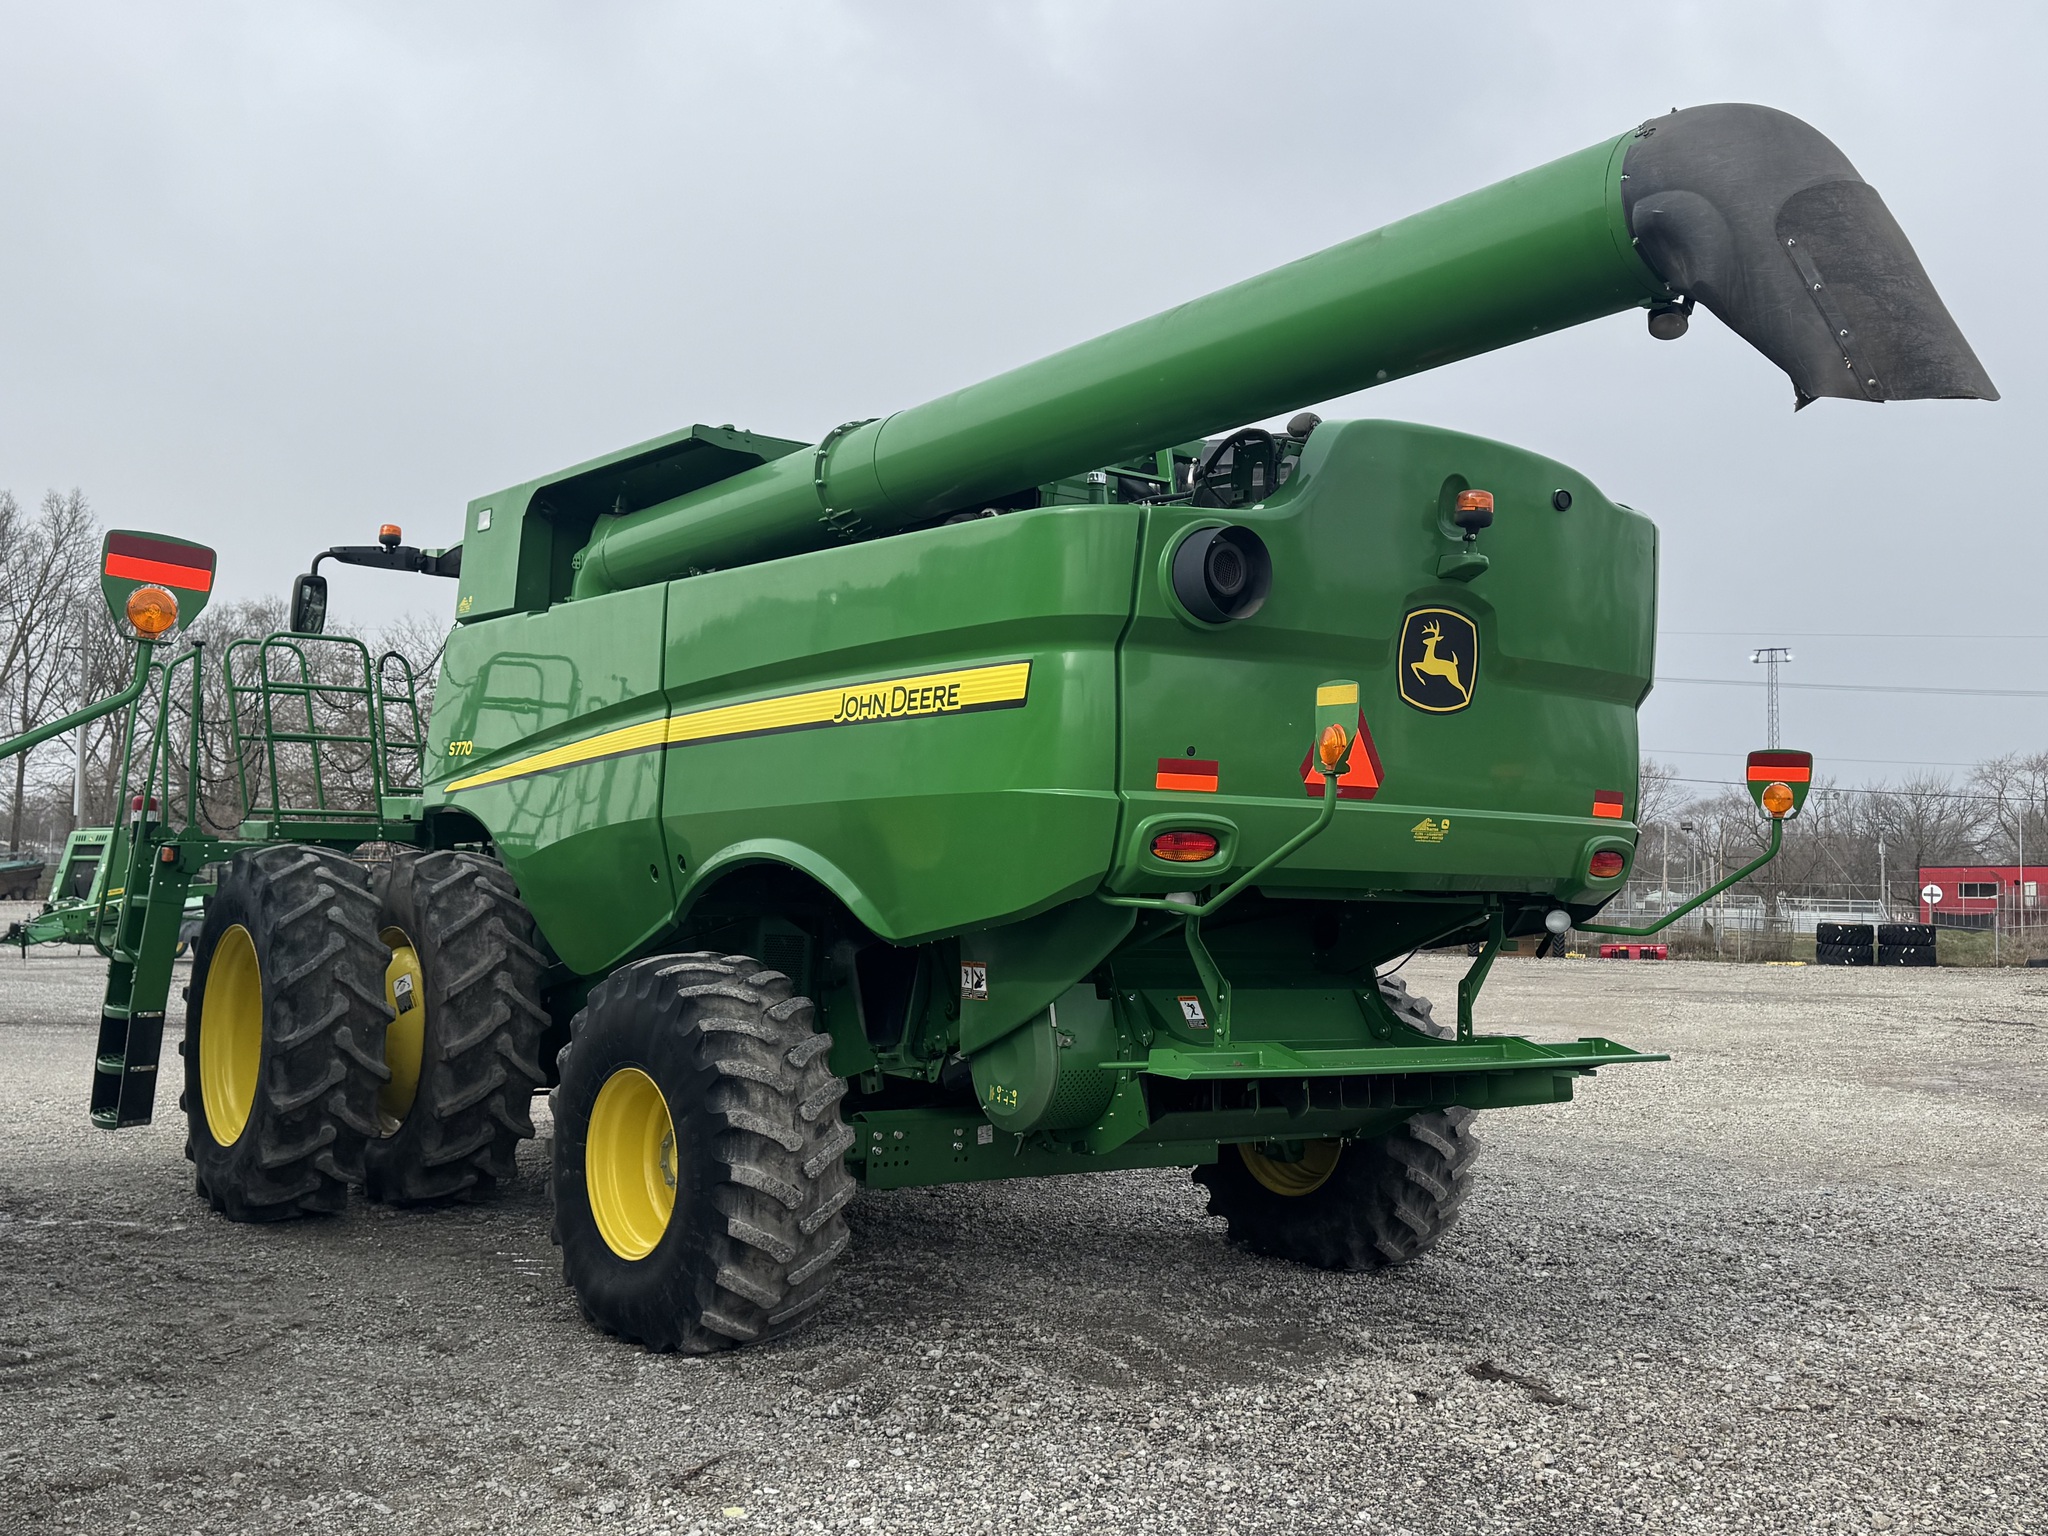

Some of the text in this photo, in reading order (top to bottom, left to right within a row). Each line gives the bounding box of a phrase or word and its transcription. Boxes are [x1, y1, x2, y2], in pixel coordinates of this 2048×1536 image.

[834, 683, 961, 720] JOHN DEERE
[448, 740, 473, 756] S770
